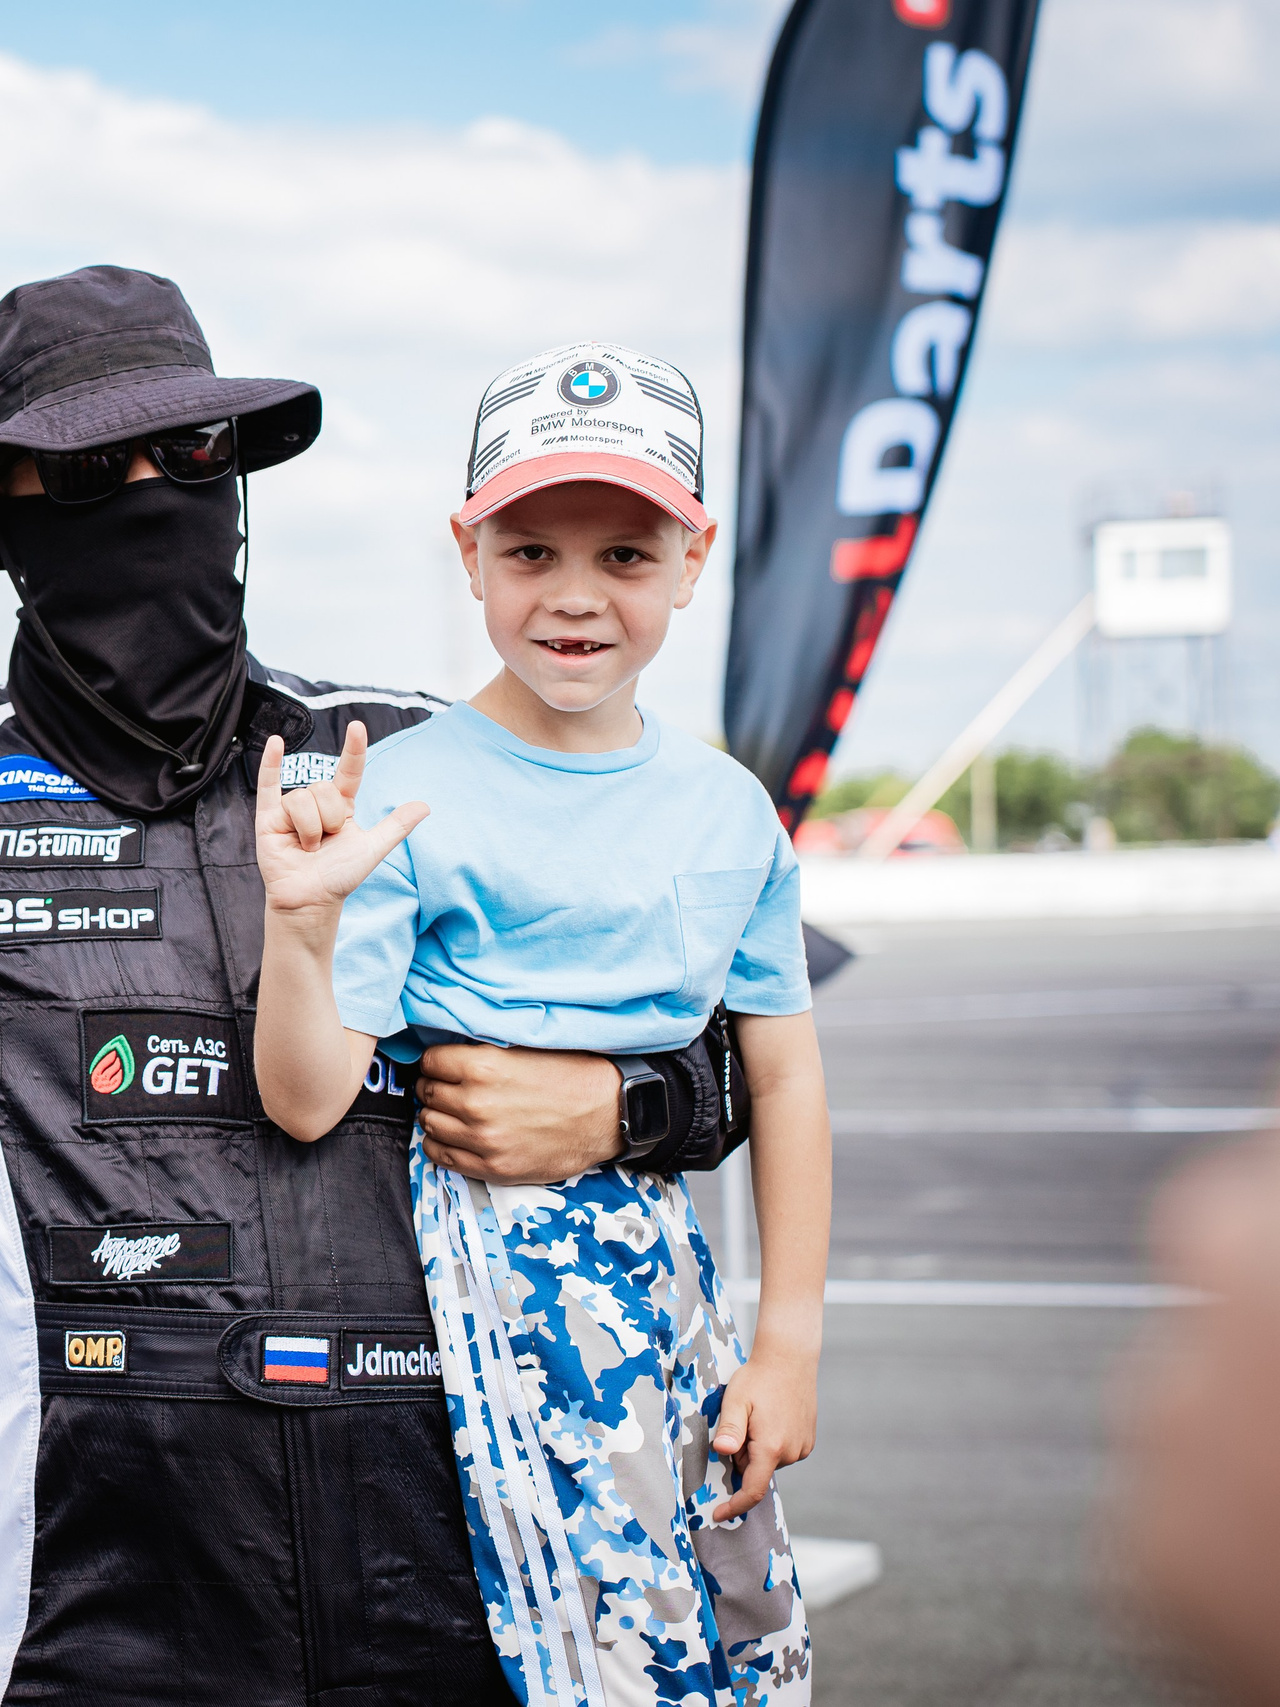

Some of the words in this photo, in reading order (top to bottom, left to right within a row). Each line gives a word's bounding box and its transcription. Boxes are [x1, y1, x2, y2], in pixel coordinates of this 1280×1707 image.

[531, 409, 573, 426] powered
[577, 408, 589, 417] by
[531, 418, 566, 436] BMW
[571, 417, 644, 437] Motorsport
[570, 434, 624, 446] Motorsport
[28, 784, 46, 793] THE
[57, 907, 155, 931] SHOP
[147, 1035, 190, 1054] Сеть
[193, 1036, 227, 1058] АЗС
[141, 1056, 230, 1096] GET
[68, 1337, 122, 1366] OMP
[347, 1343, 441, 1376] Jdmche
